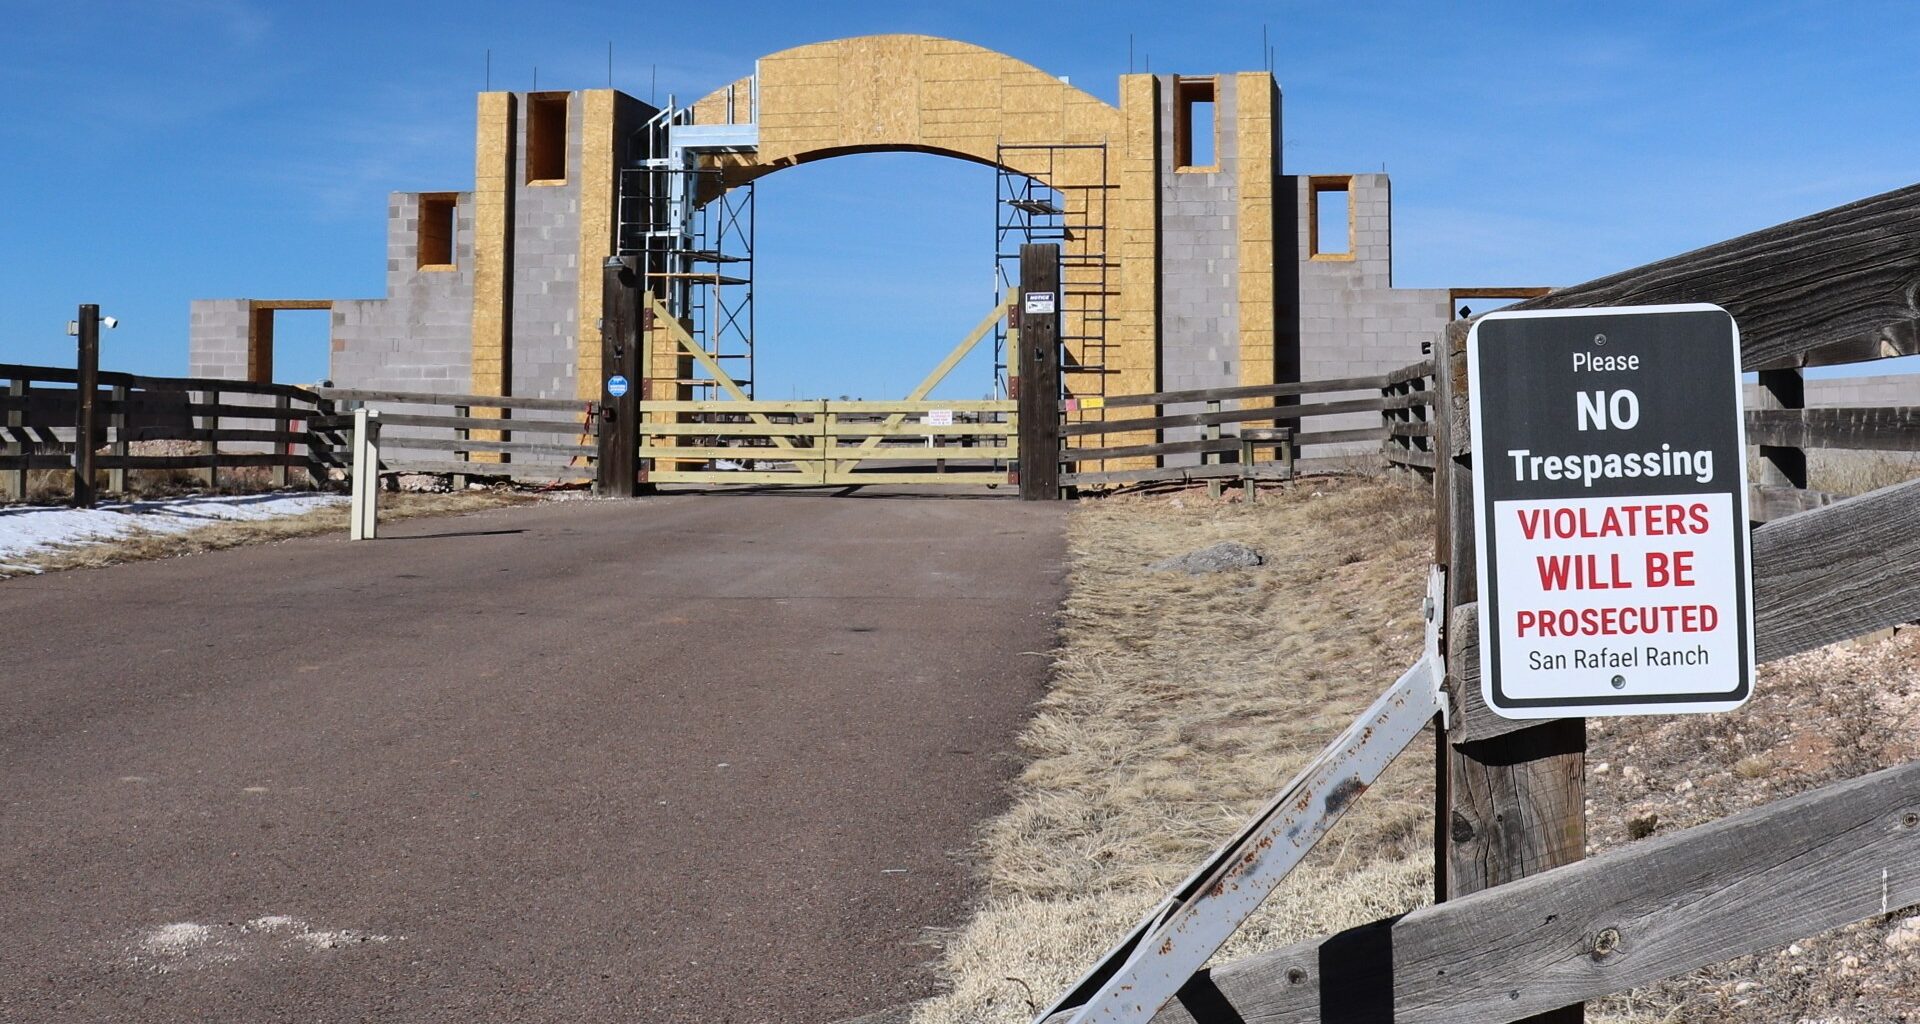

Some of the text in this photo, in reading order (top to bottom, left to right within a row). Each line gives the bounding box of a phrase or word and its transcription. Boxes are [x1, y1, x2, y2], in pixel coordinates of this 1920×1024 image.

[1573, 352, 1640, 372] Please
[1576, 389, 1640, 431] NO
[1508, 444, 1714, 487] Trespassing
[1517, 503, 1709, 540] VIOLATERS
[1536, 551, 1695, 591] WILL BE
[1517, 605, 1718, 638] PROSECUTED
[1529, 644, 1709, 671] San Rafael Ranch
